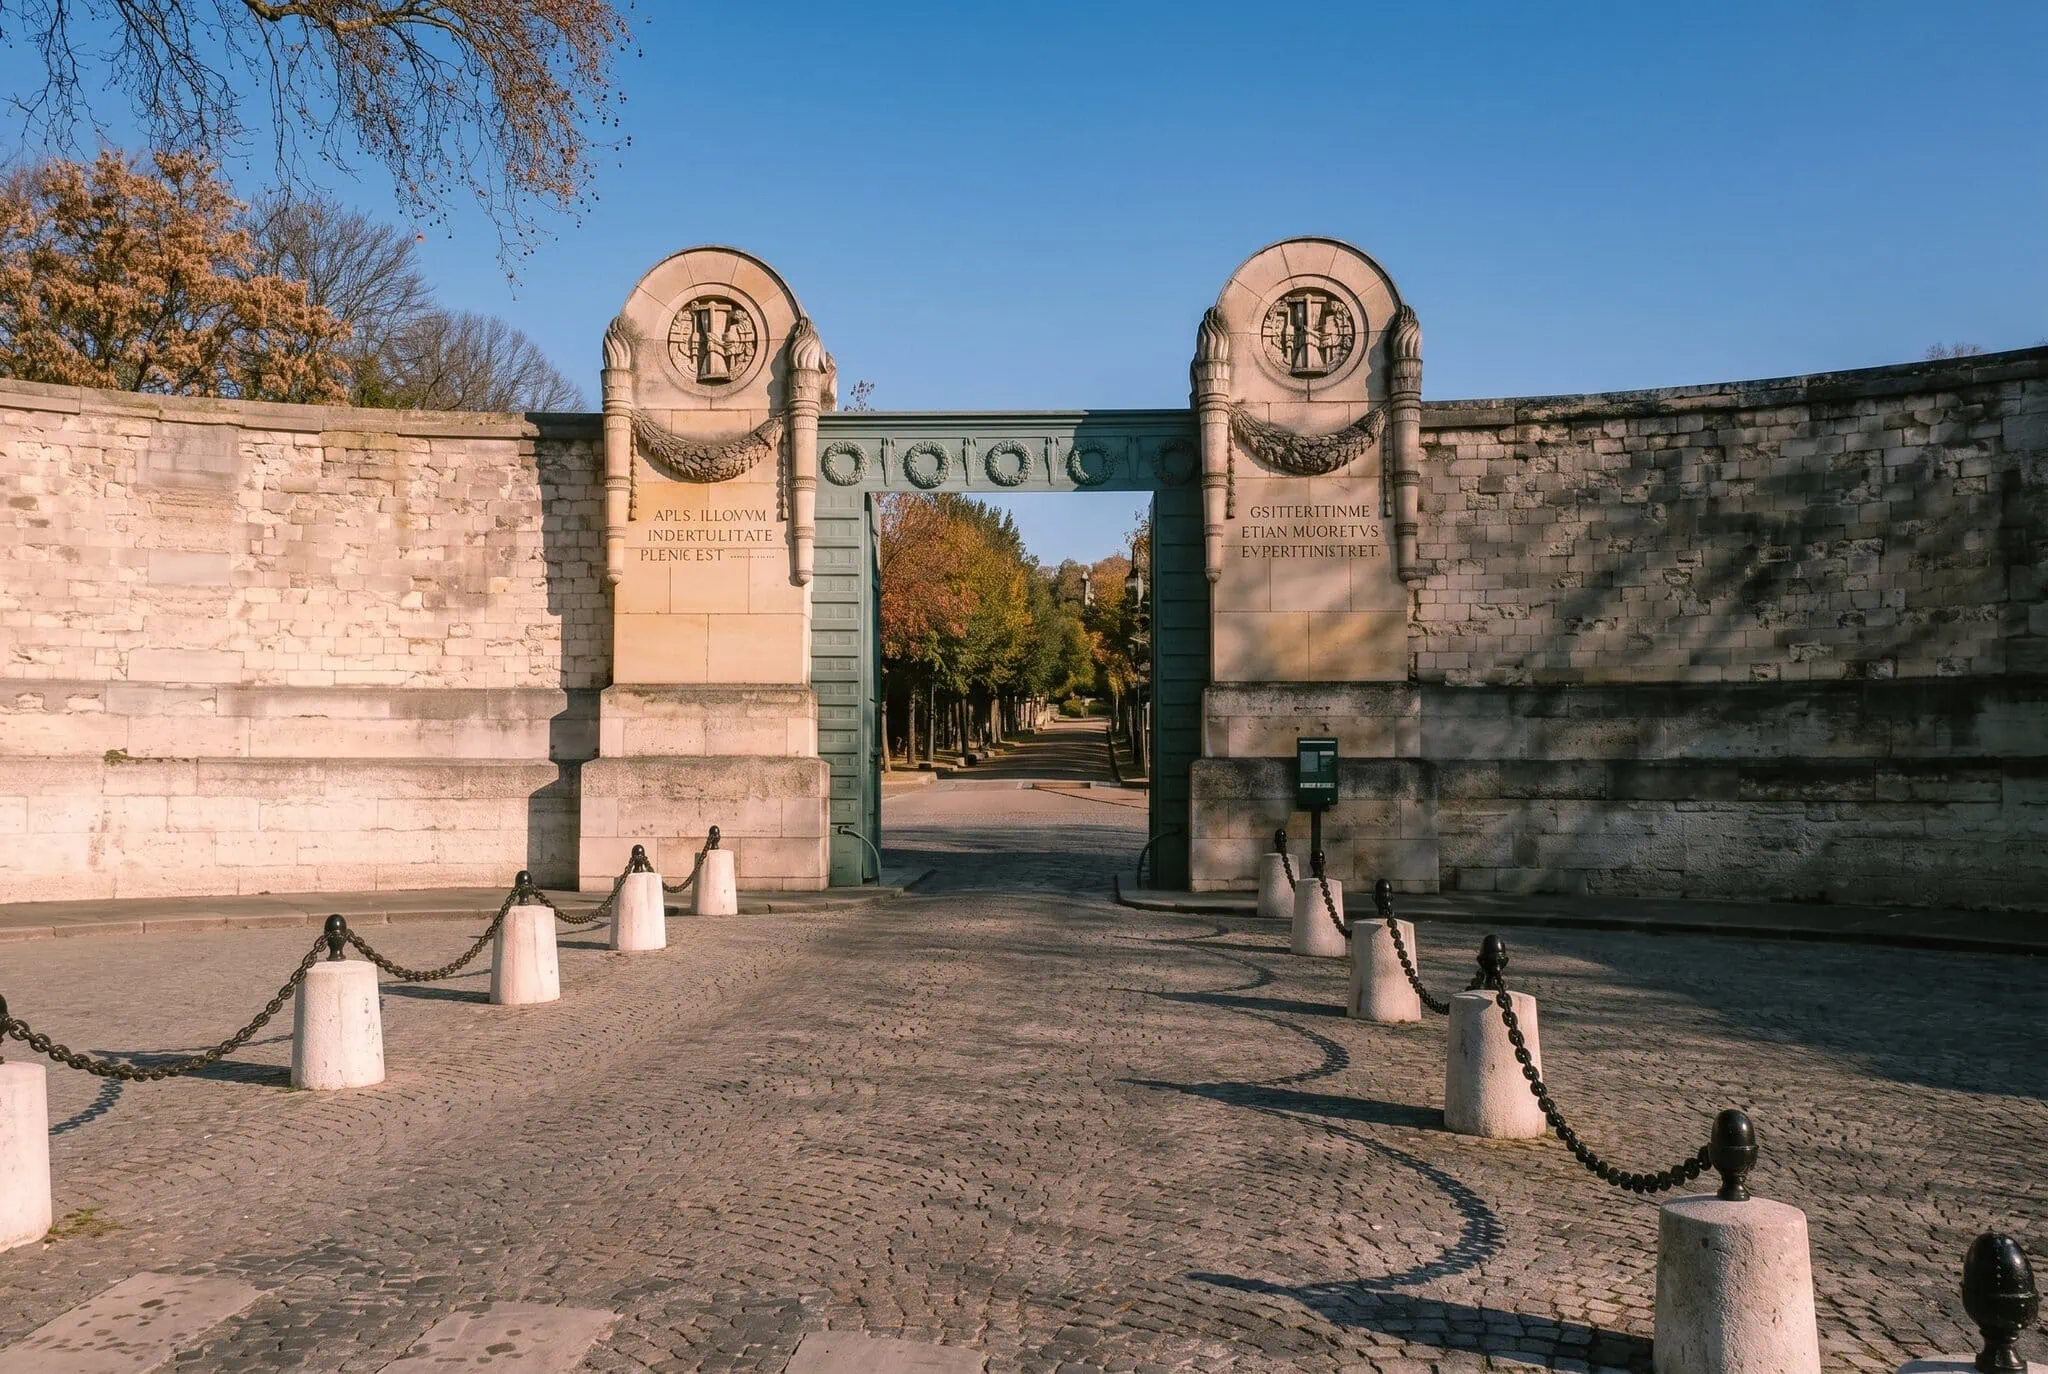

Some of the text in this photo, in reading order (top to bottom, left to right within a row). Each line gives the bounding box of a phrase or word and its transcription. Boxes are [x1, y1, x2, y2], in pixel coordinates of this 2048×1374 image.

[648, 529, 773, 542] INDERTULITATE
[1242, 525, 1288, 539] ETIAN
[696, 549, 725, 562] EST
